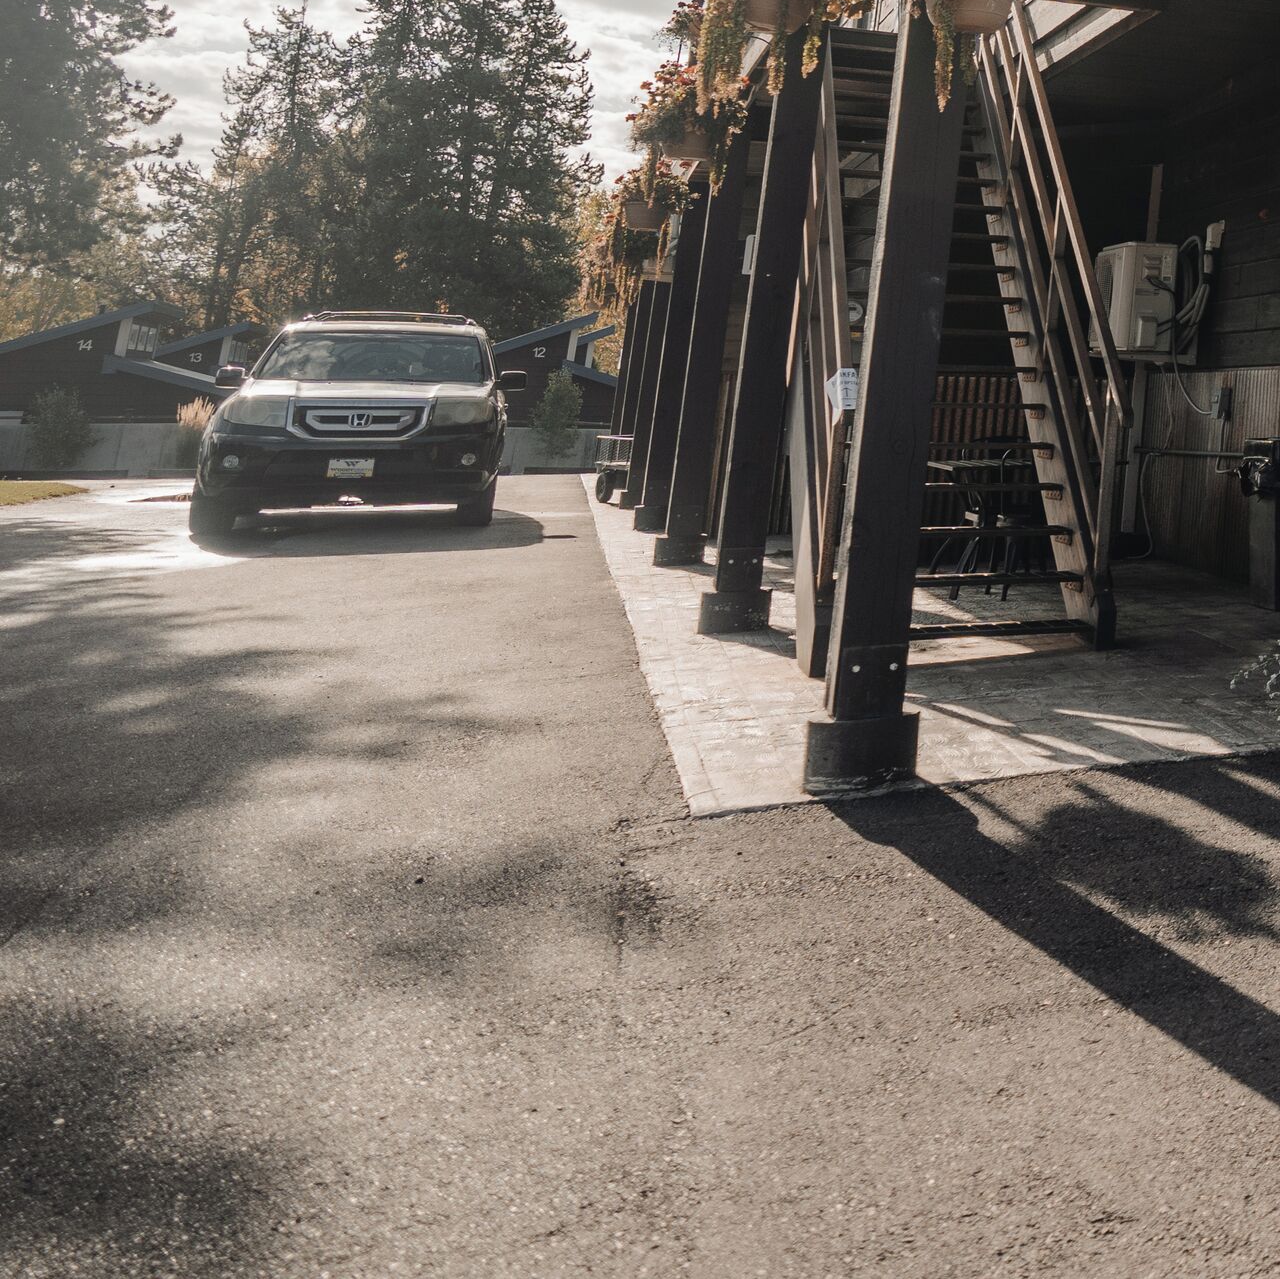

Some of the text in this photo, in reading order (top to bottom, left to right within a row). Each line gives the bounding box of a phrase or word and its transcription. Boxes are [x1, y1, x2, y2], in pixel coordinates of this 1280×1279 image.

[77, 339, 93, 351] 14
[189, 352, 202, 363] 13
[532, 346, 546, 358] 12
